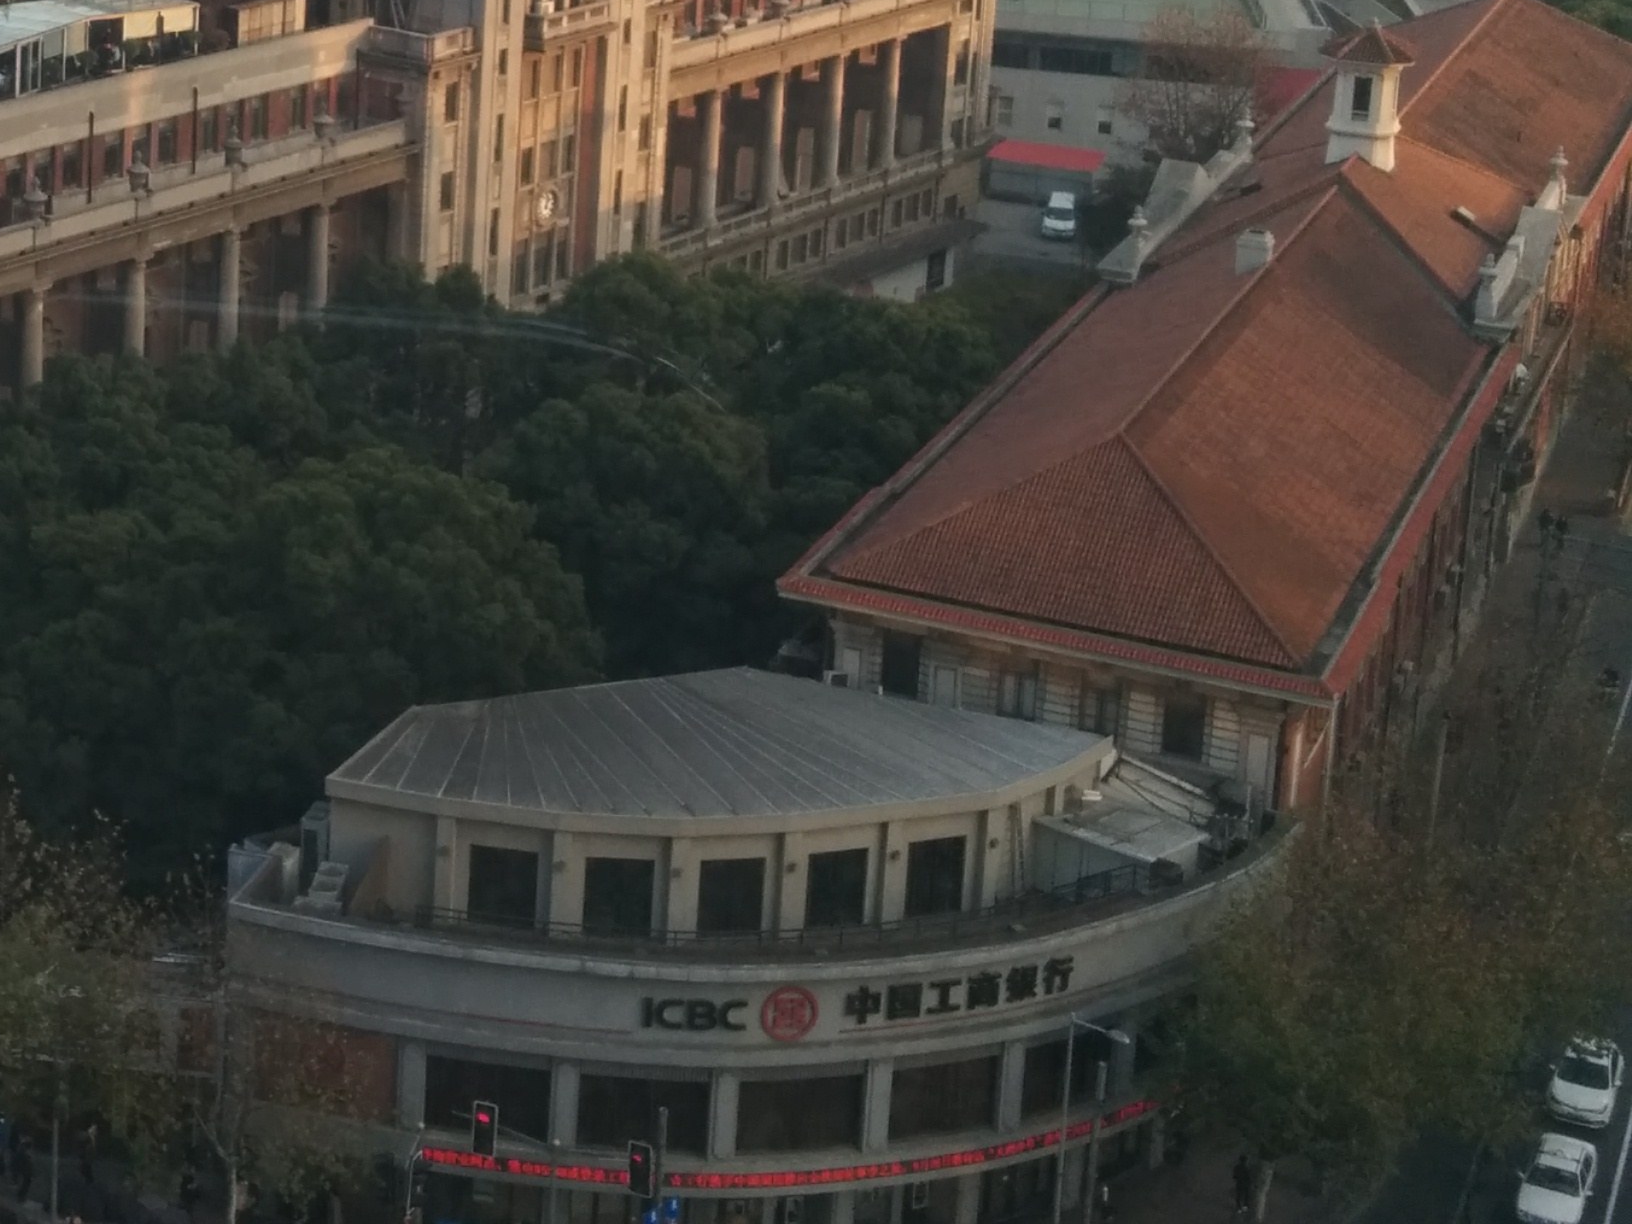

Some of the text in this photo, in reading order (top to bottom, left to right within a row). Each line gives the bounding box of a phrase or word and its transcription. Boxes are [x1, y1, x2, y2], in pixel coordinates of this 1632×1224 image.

[640, 996, 749, 1032] ICBC
[844, 954, 1075, 1025] 中国工商银行
